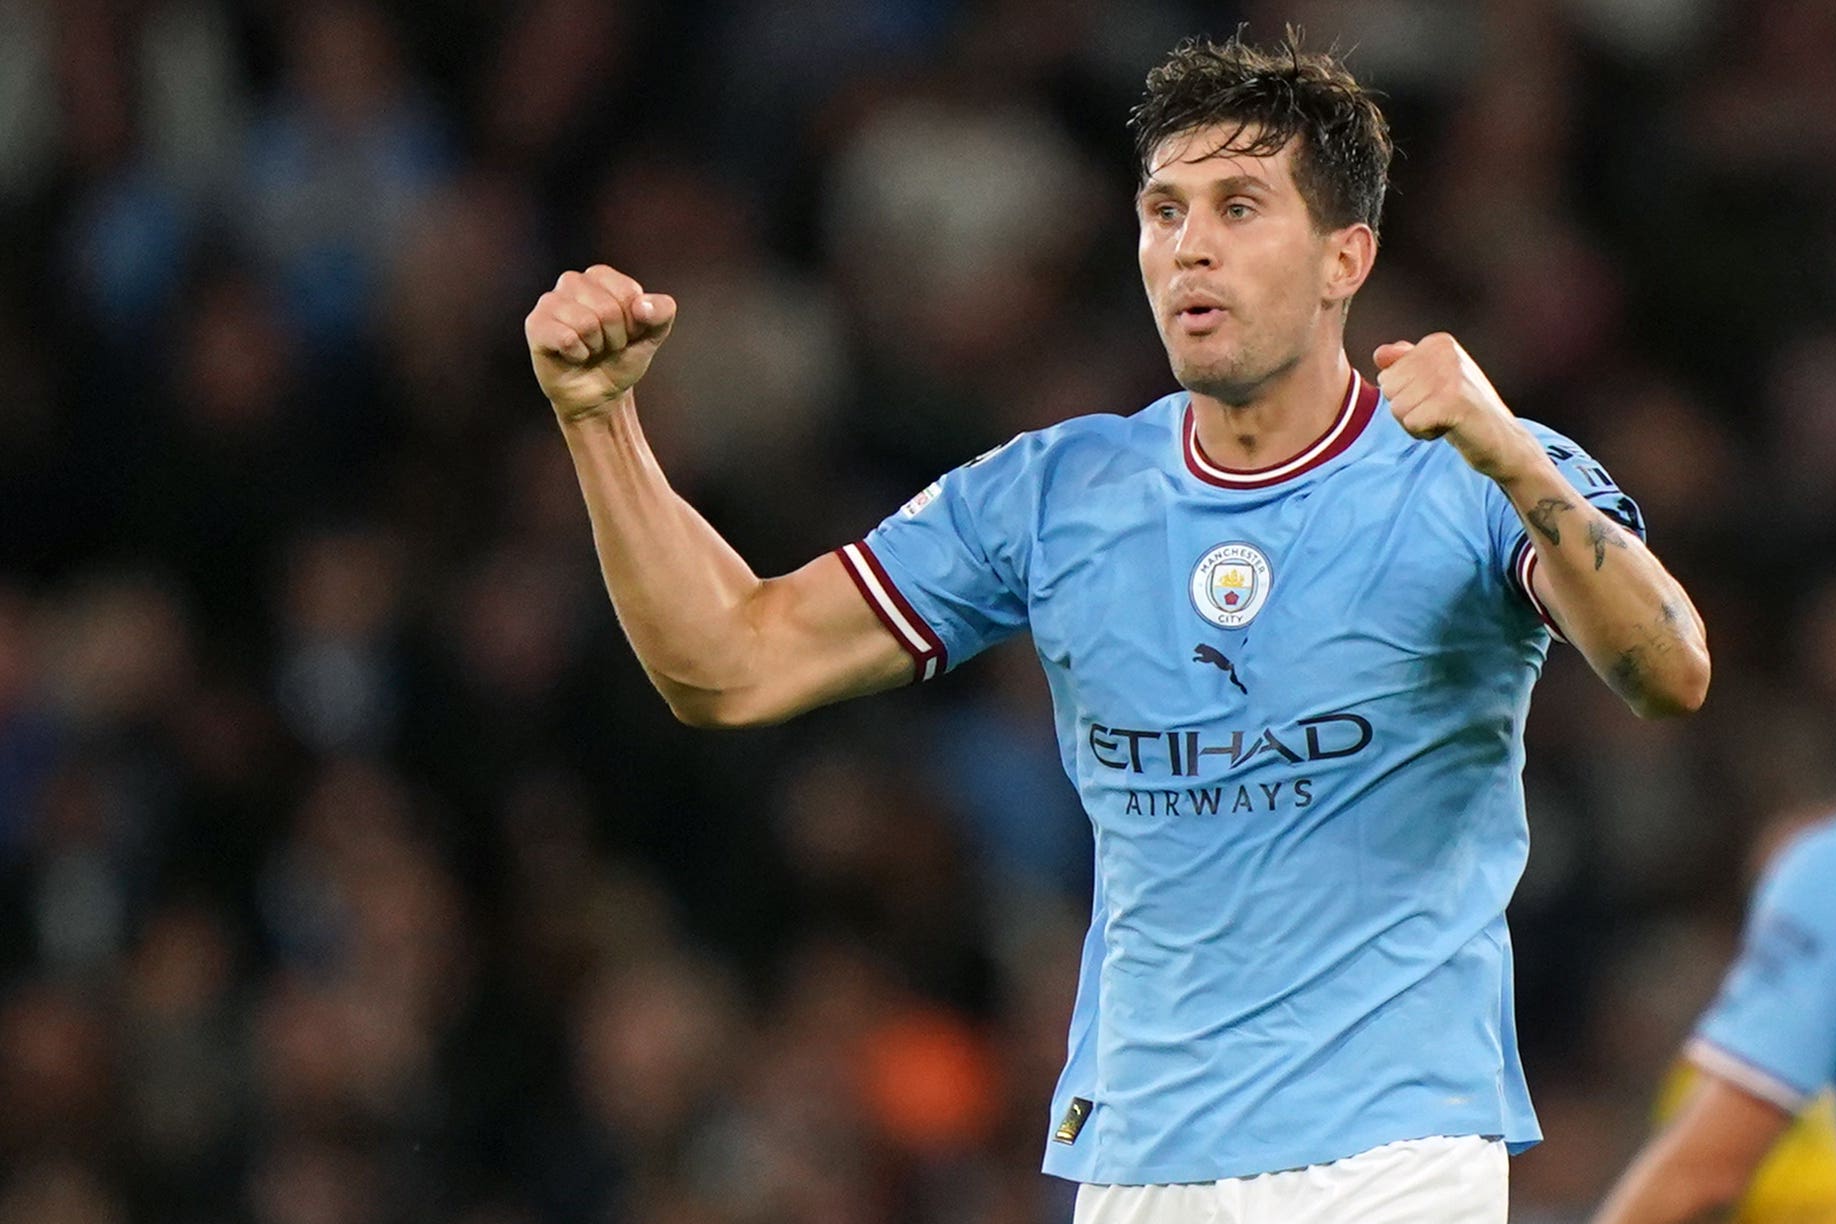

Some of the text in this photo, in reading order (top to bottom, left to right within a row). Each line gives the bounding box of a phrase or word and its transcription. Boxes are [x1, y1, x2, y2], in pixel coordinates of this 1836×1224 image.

[1200, 548, 1266, 575] MANCHESTER
[1217, 614, 1244, 623] CITY
[1089, 713, 1373, 777] ETIHAD
[1125, 779, 1314, 817] AIRWAYS
